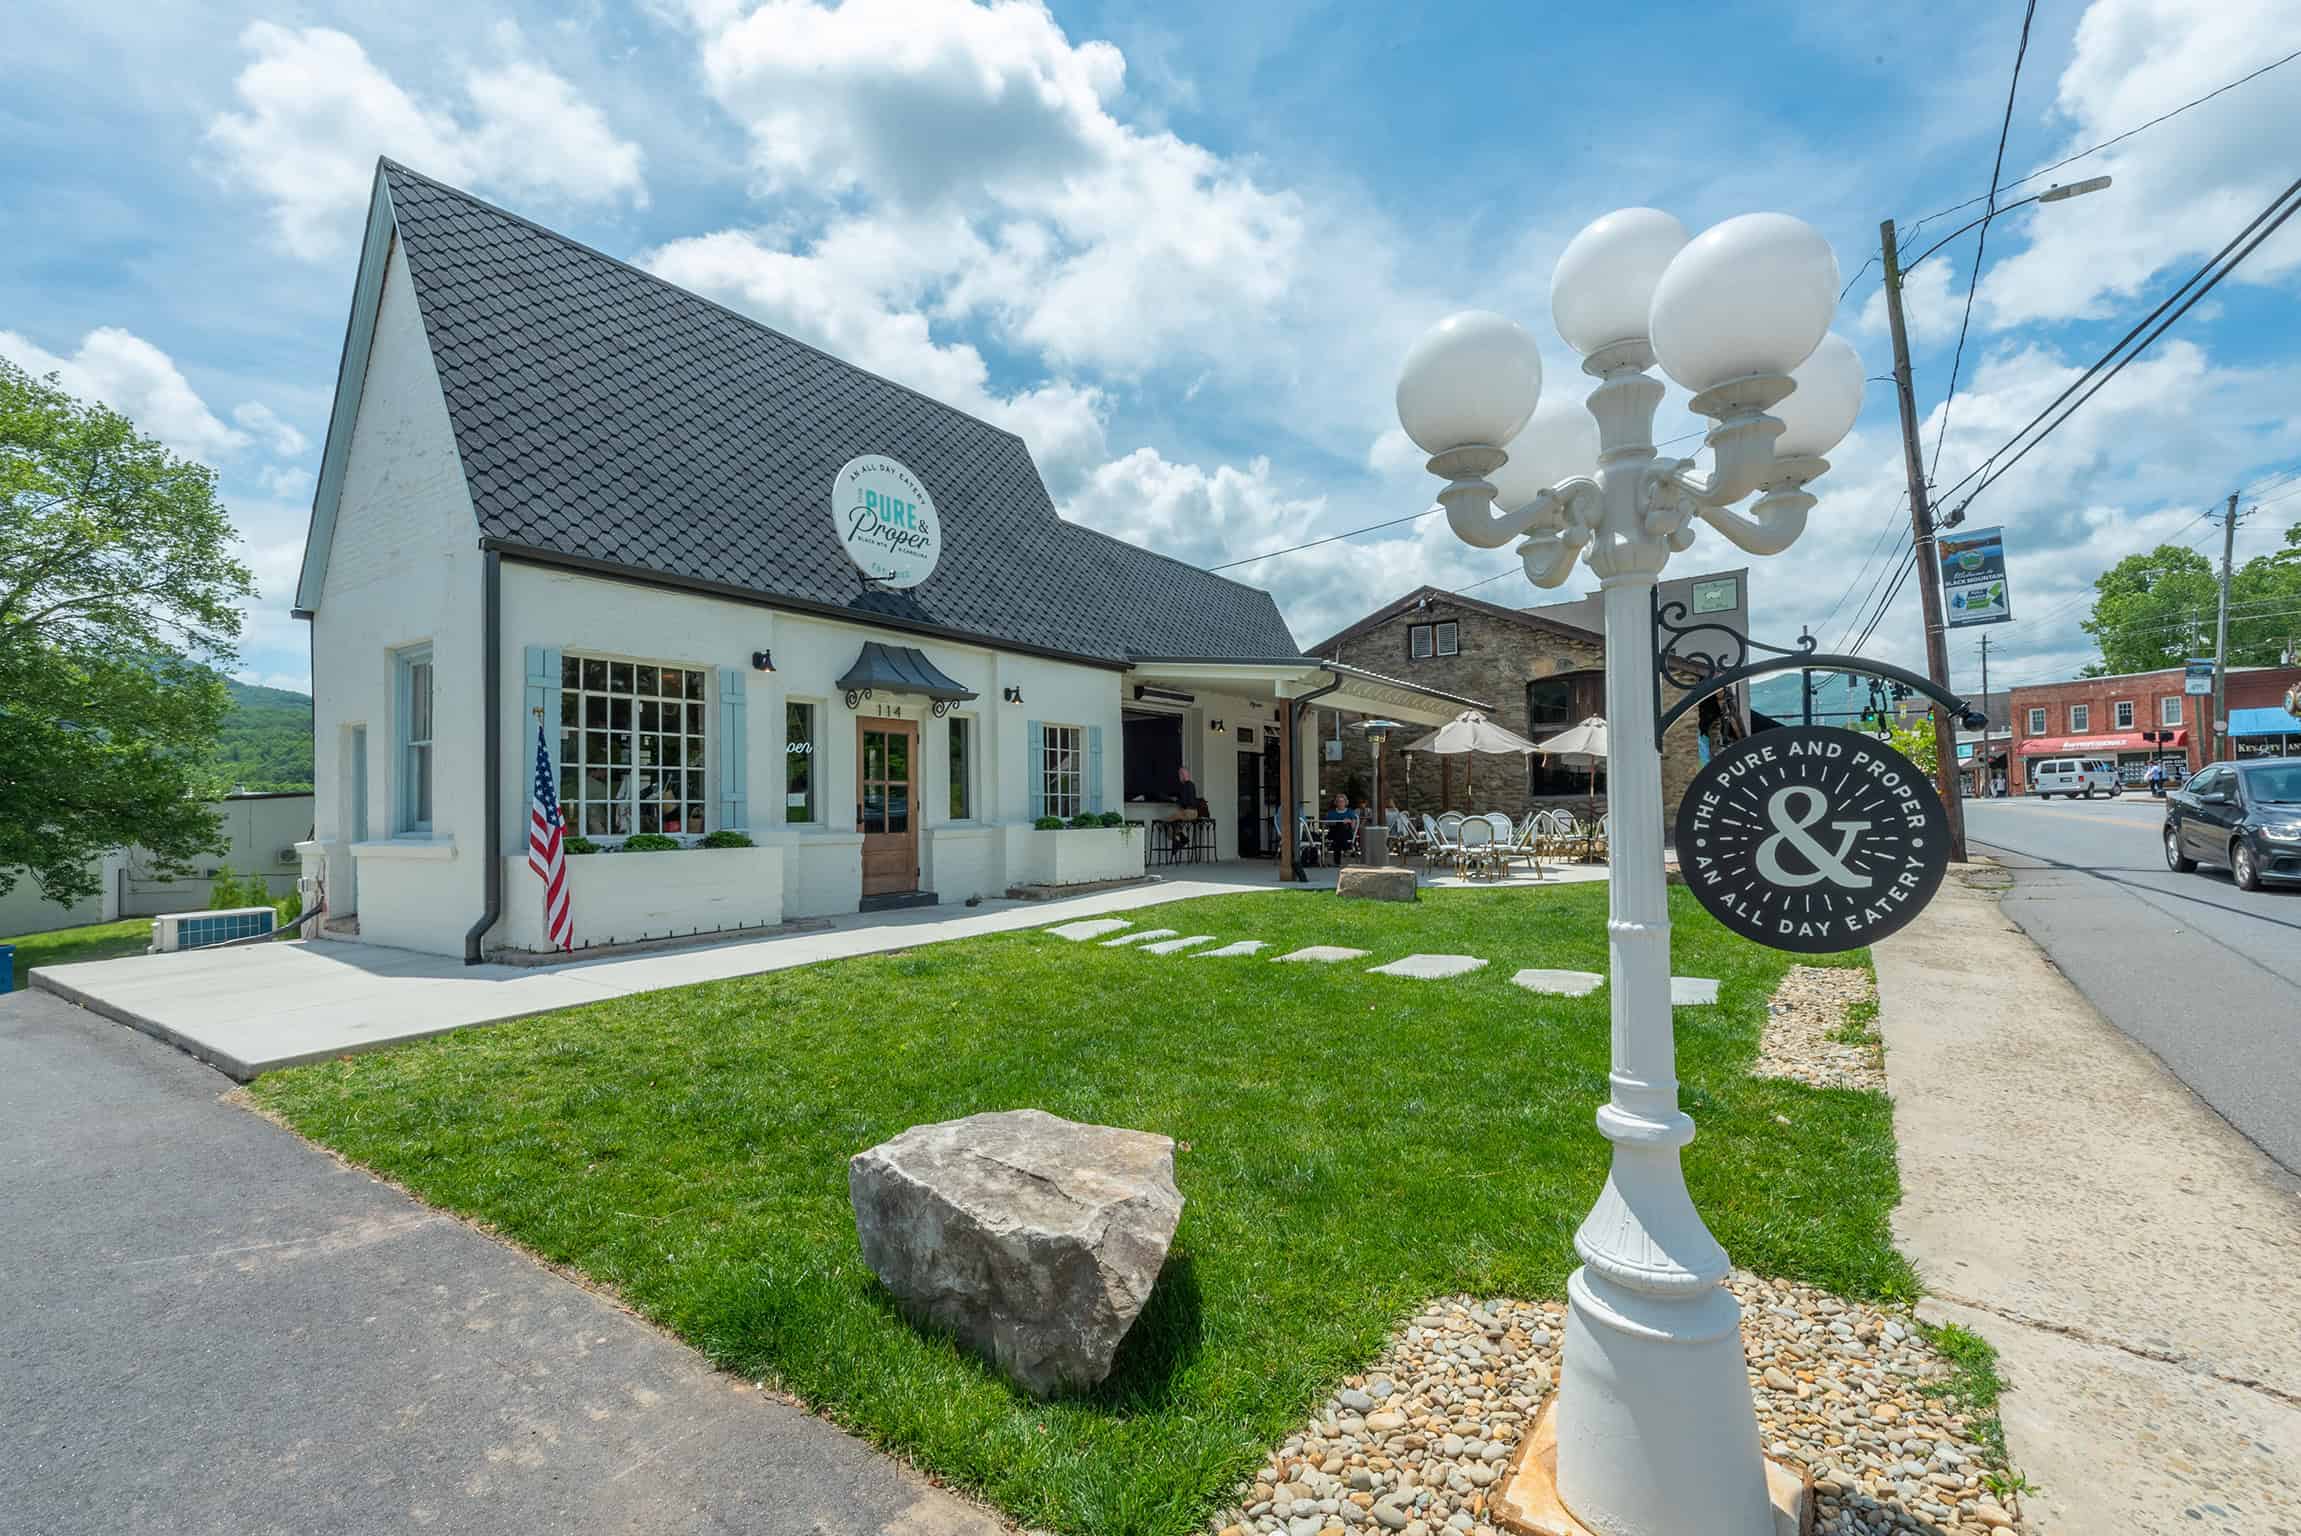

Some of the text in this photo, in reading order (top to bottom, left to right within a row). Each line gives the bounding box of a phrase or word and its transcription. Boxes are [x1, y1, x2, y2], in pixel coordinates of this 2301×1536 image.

[850, 471, 860, 481] AN
[862, 464, 877, 472] ALL
[880, 464, 896, 474] DAY
[848, 506, 931, 553] Proper
[866, 489, 917, 531] PURE
[919, 520, 929, 535] &
[878, 704, 902, 718] 114
[1693, 741, 1926, 831] THE PURE AND PROPER
[1755, 786, 1873, 889] &
[1696, 856, 1925, 937] AN ALL DAY EATERY
